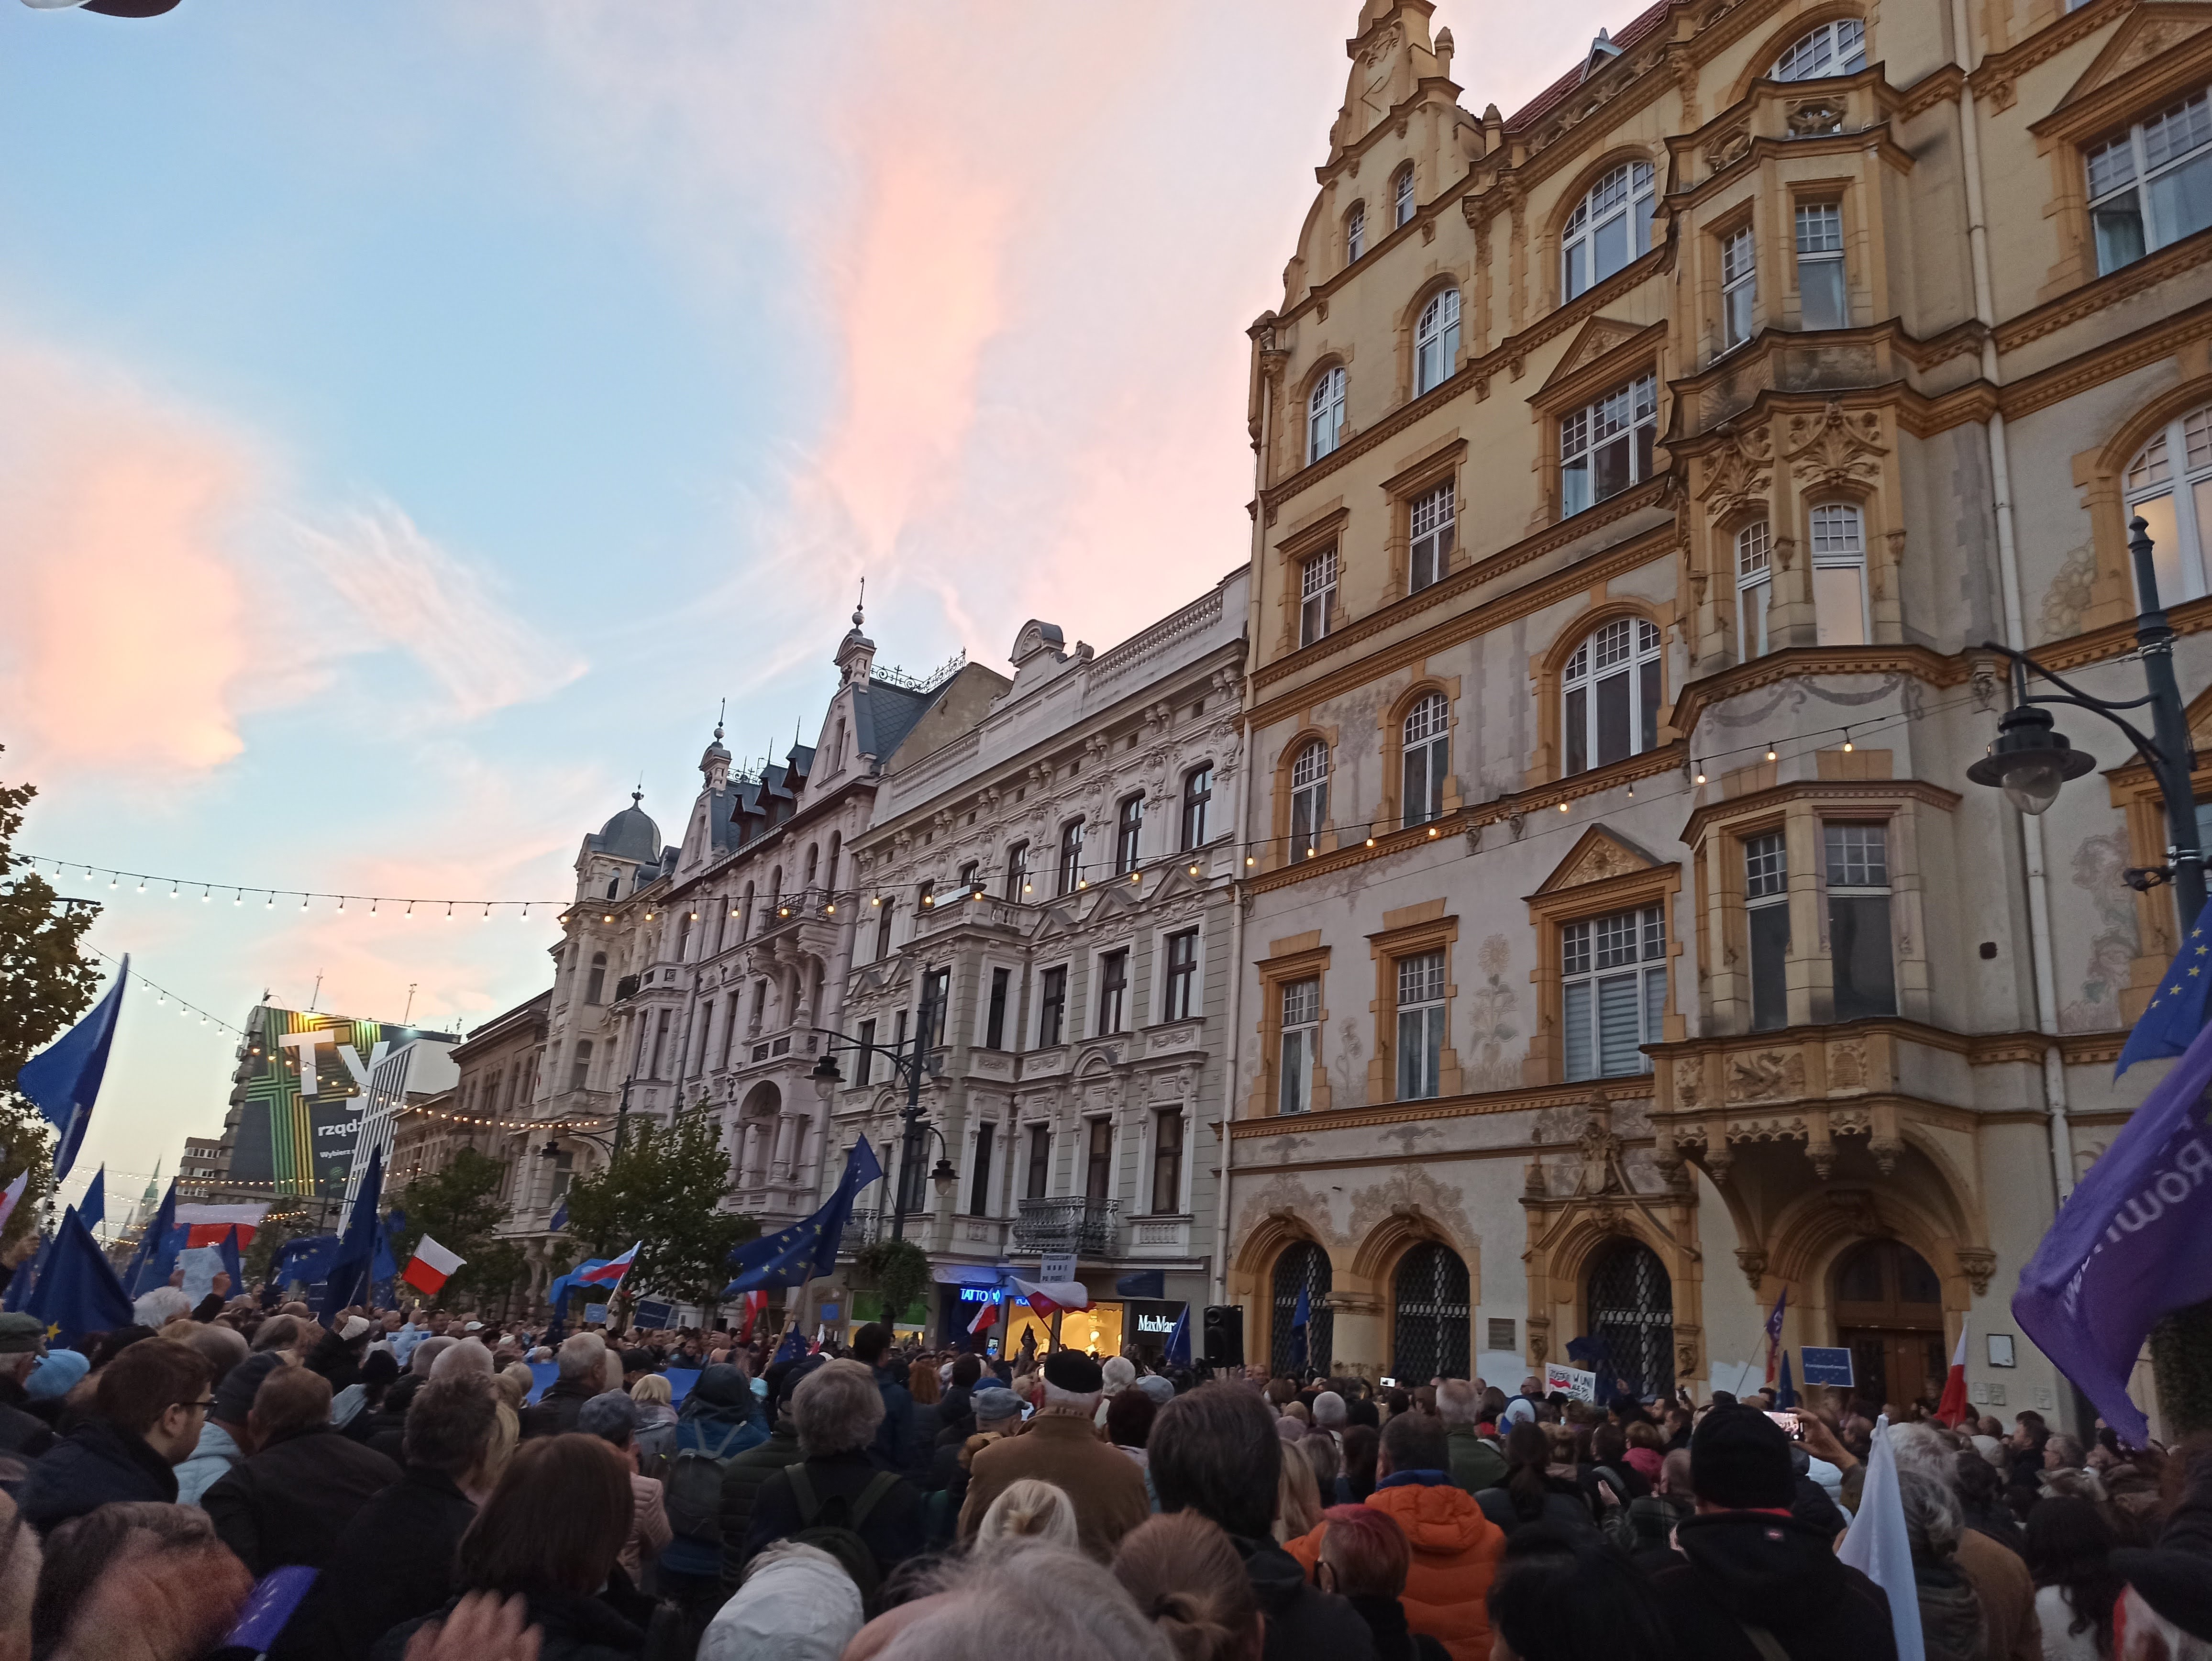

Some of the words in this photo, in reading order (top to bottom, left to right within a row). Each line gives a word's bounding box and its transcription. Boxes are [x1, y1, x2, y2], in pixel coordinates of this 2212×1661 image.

[278, 1029, 390, 1111] Ty
[960, 1288, 995, 1302] TATTO
[1137, 1314, 1177, 1333] MaxMar
